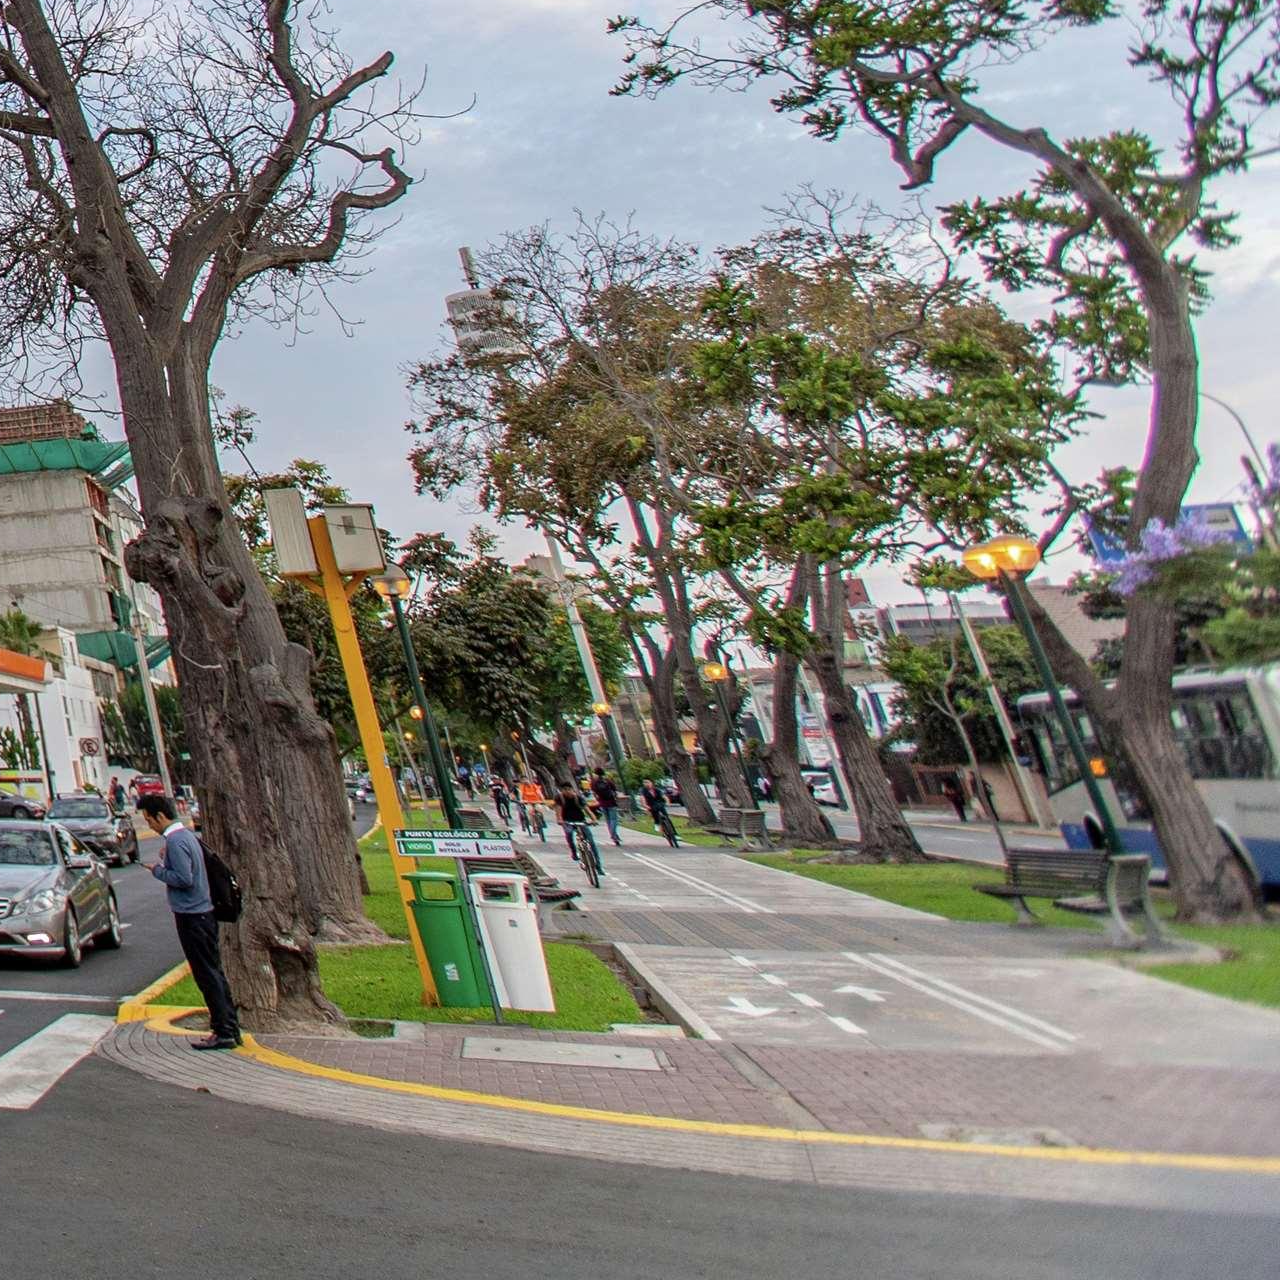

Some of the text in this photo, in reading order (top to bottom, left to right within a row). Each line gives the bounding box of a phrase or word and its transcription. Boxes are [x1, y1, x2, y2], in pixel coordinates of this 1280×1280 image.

[405, 828, 479, 838] PUNTO ECOLÓGICO
[407, 841, 431, 850] VIDRIO
